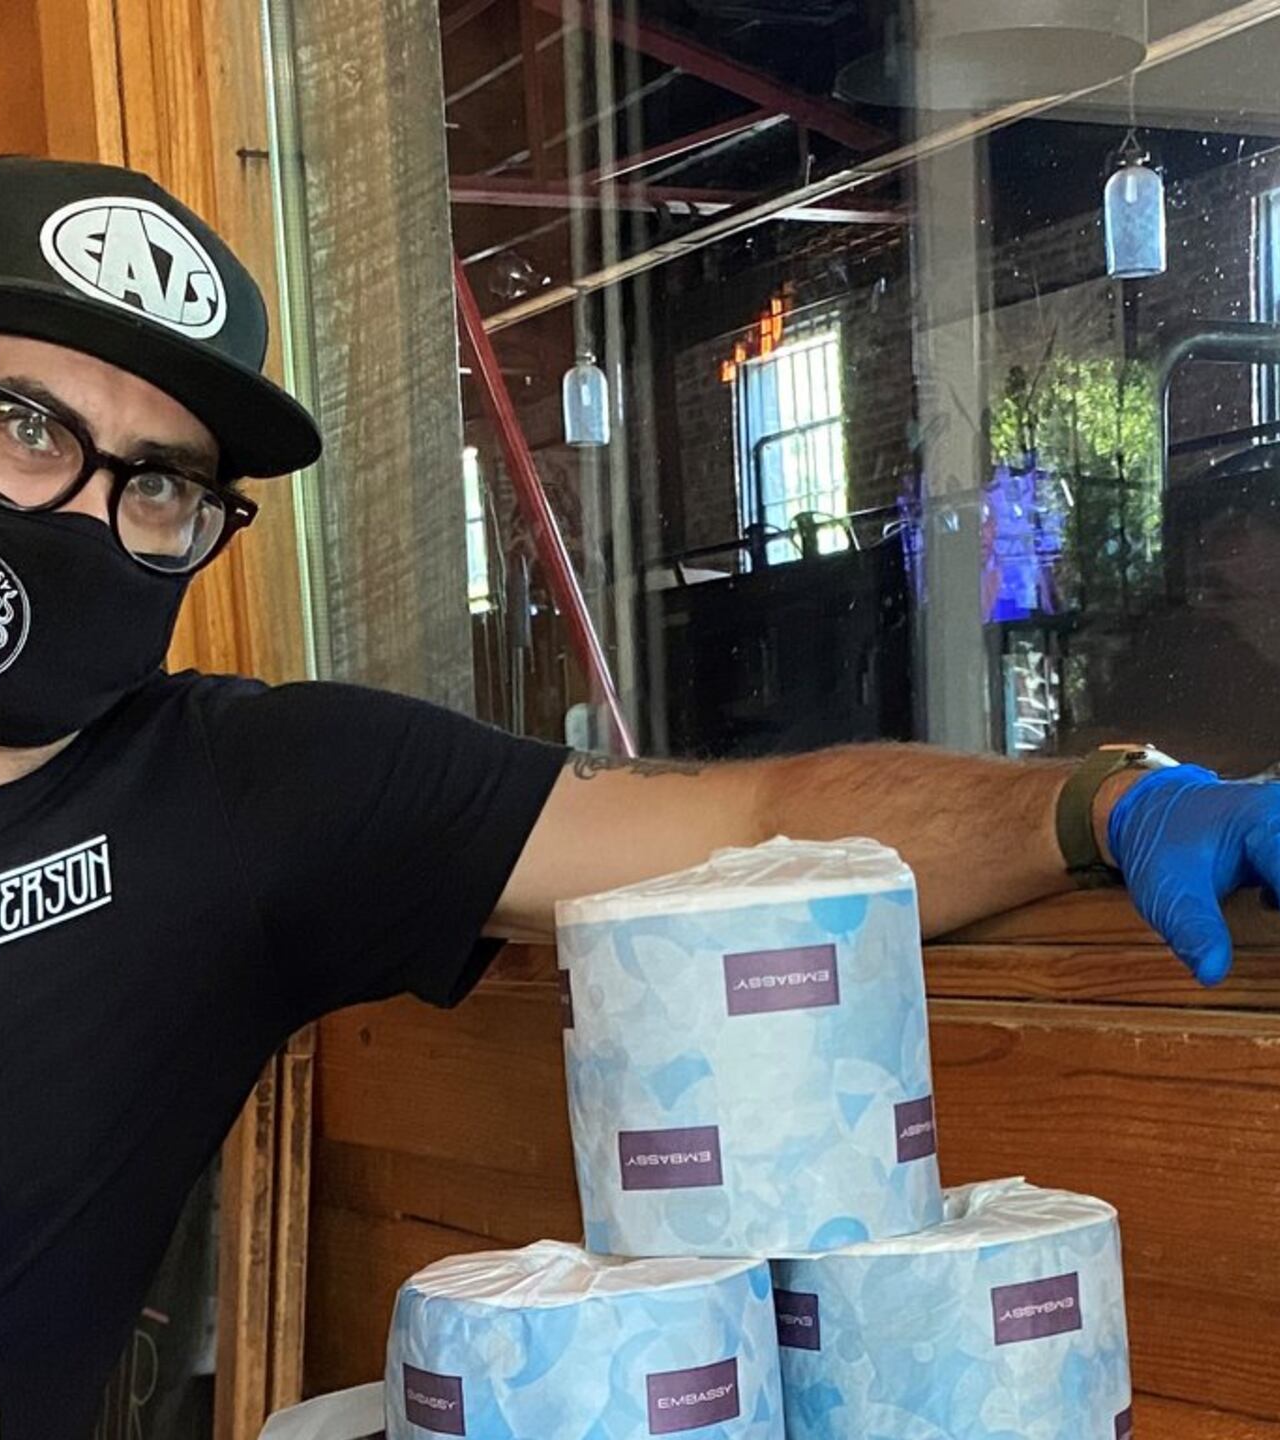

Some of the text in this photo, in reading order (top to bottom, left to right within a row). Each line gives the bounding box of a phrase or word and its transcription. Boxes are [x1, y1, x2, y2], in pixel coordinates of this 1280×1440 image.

[54, 206, 219, 326] EATS
[733, 970, 830, 991] EMBASSY
[625, 1151, 712, 1166] EMBASSY
[999, 1296, 1075, 1322] EMBASSY
[657, 1383, 734, 1410] EMBASSY
